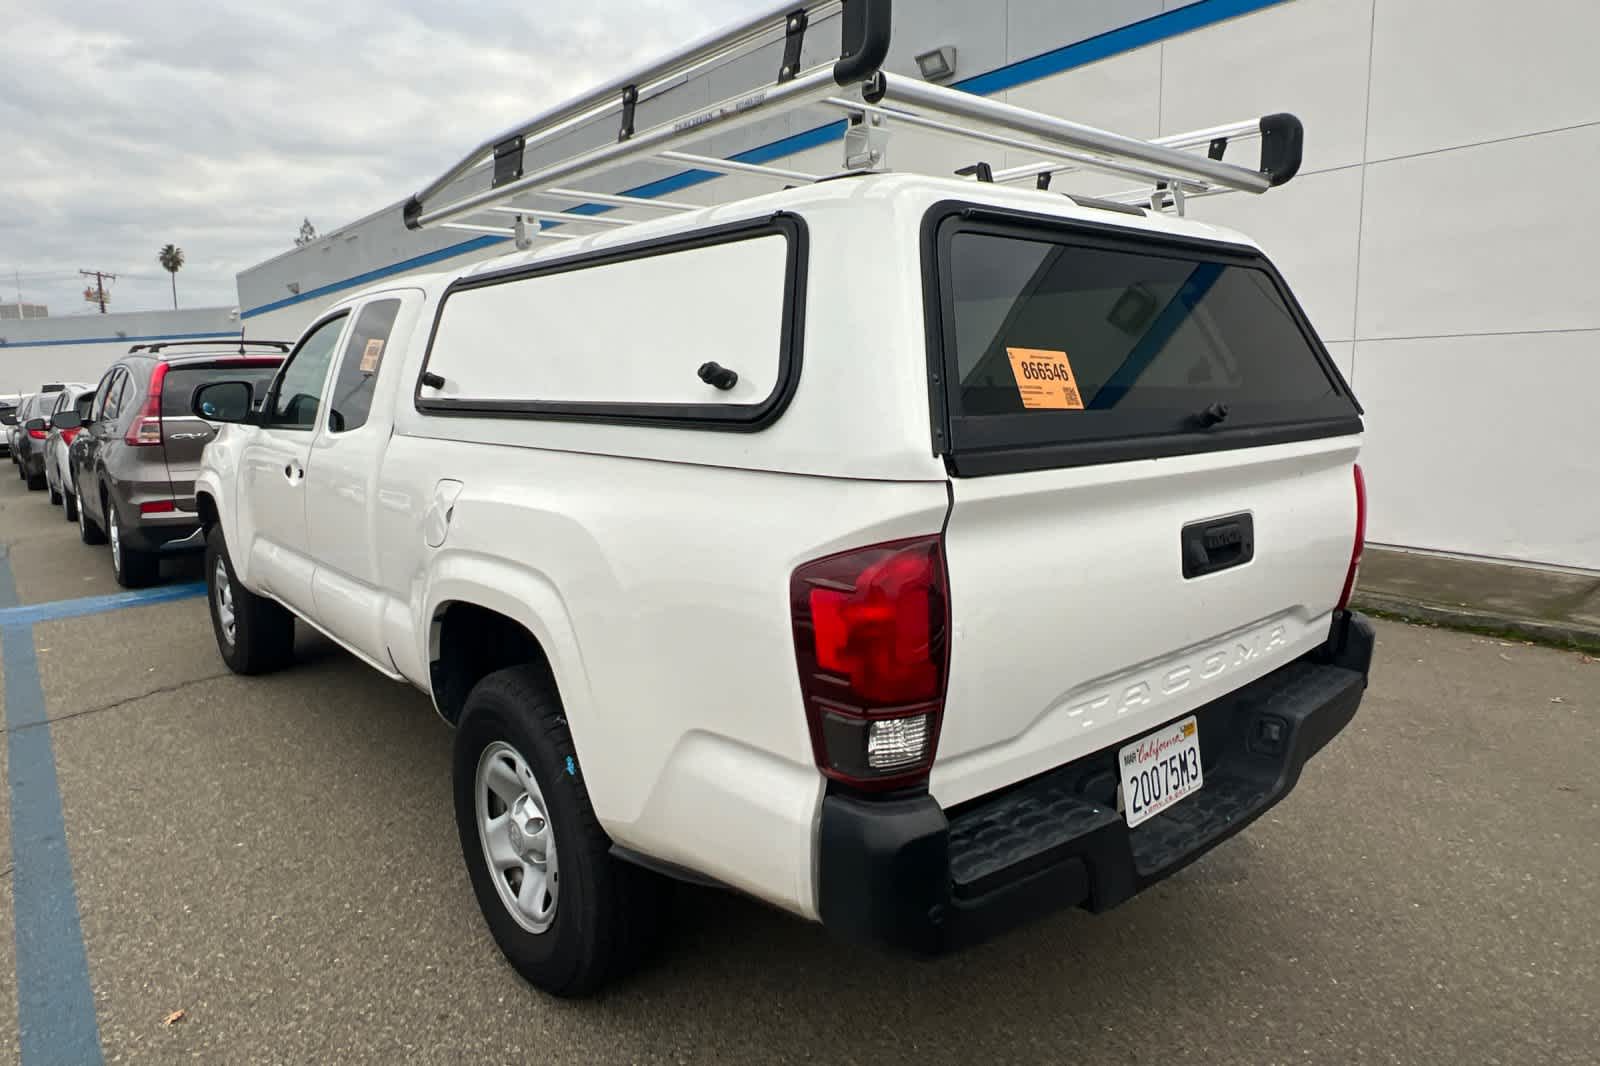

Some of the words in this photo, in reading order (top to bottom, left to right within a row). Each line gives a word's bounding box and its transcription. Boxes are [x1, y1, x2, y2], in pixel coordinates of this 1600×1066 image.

[1021, 361, 1069, 381] 866546
[1067, 625, 1287, 728] TACOMA
[1137, 734, 1185, 764] California
[1130, 746, 1198, 813] 20075M3
